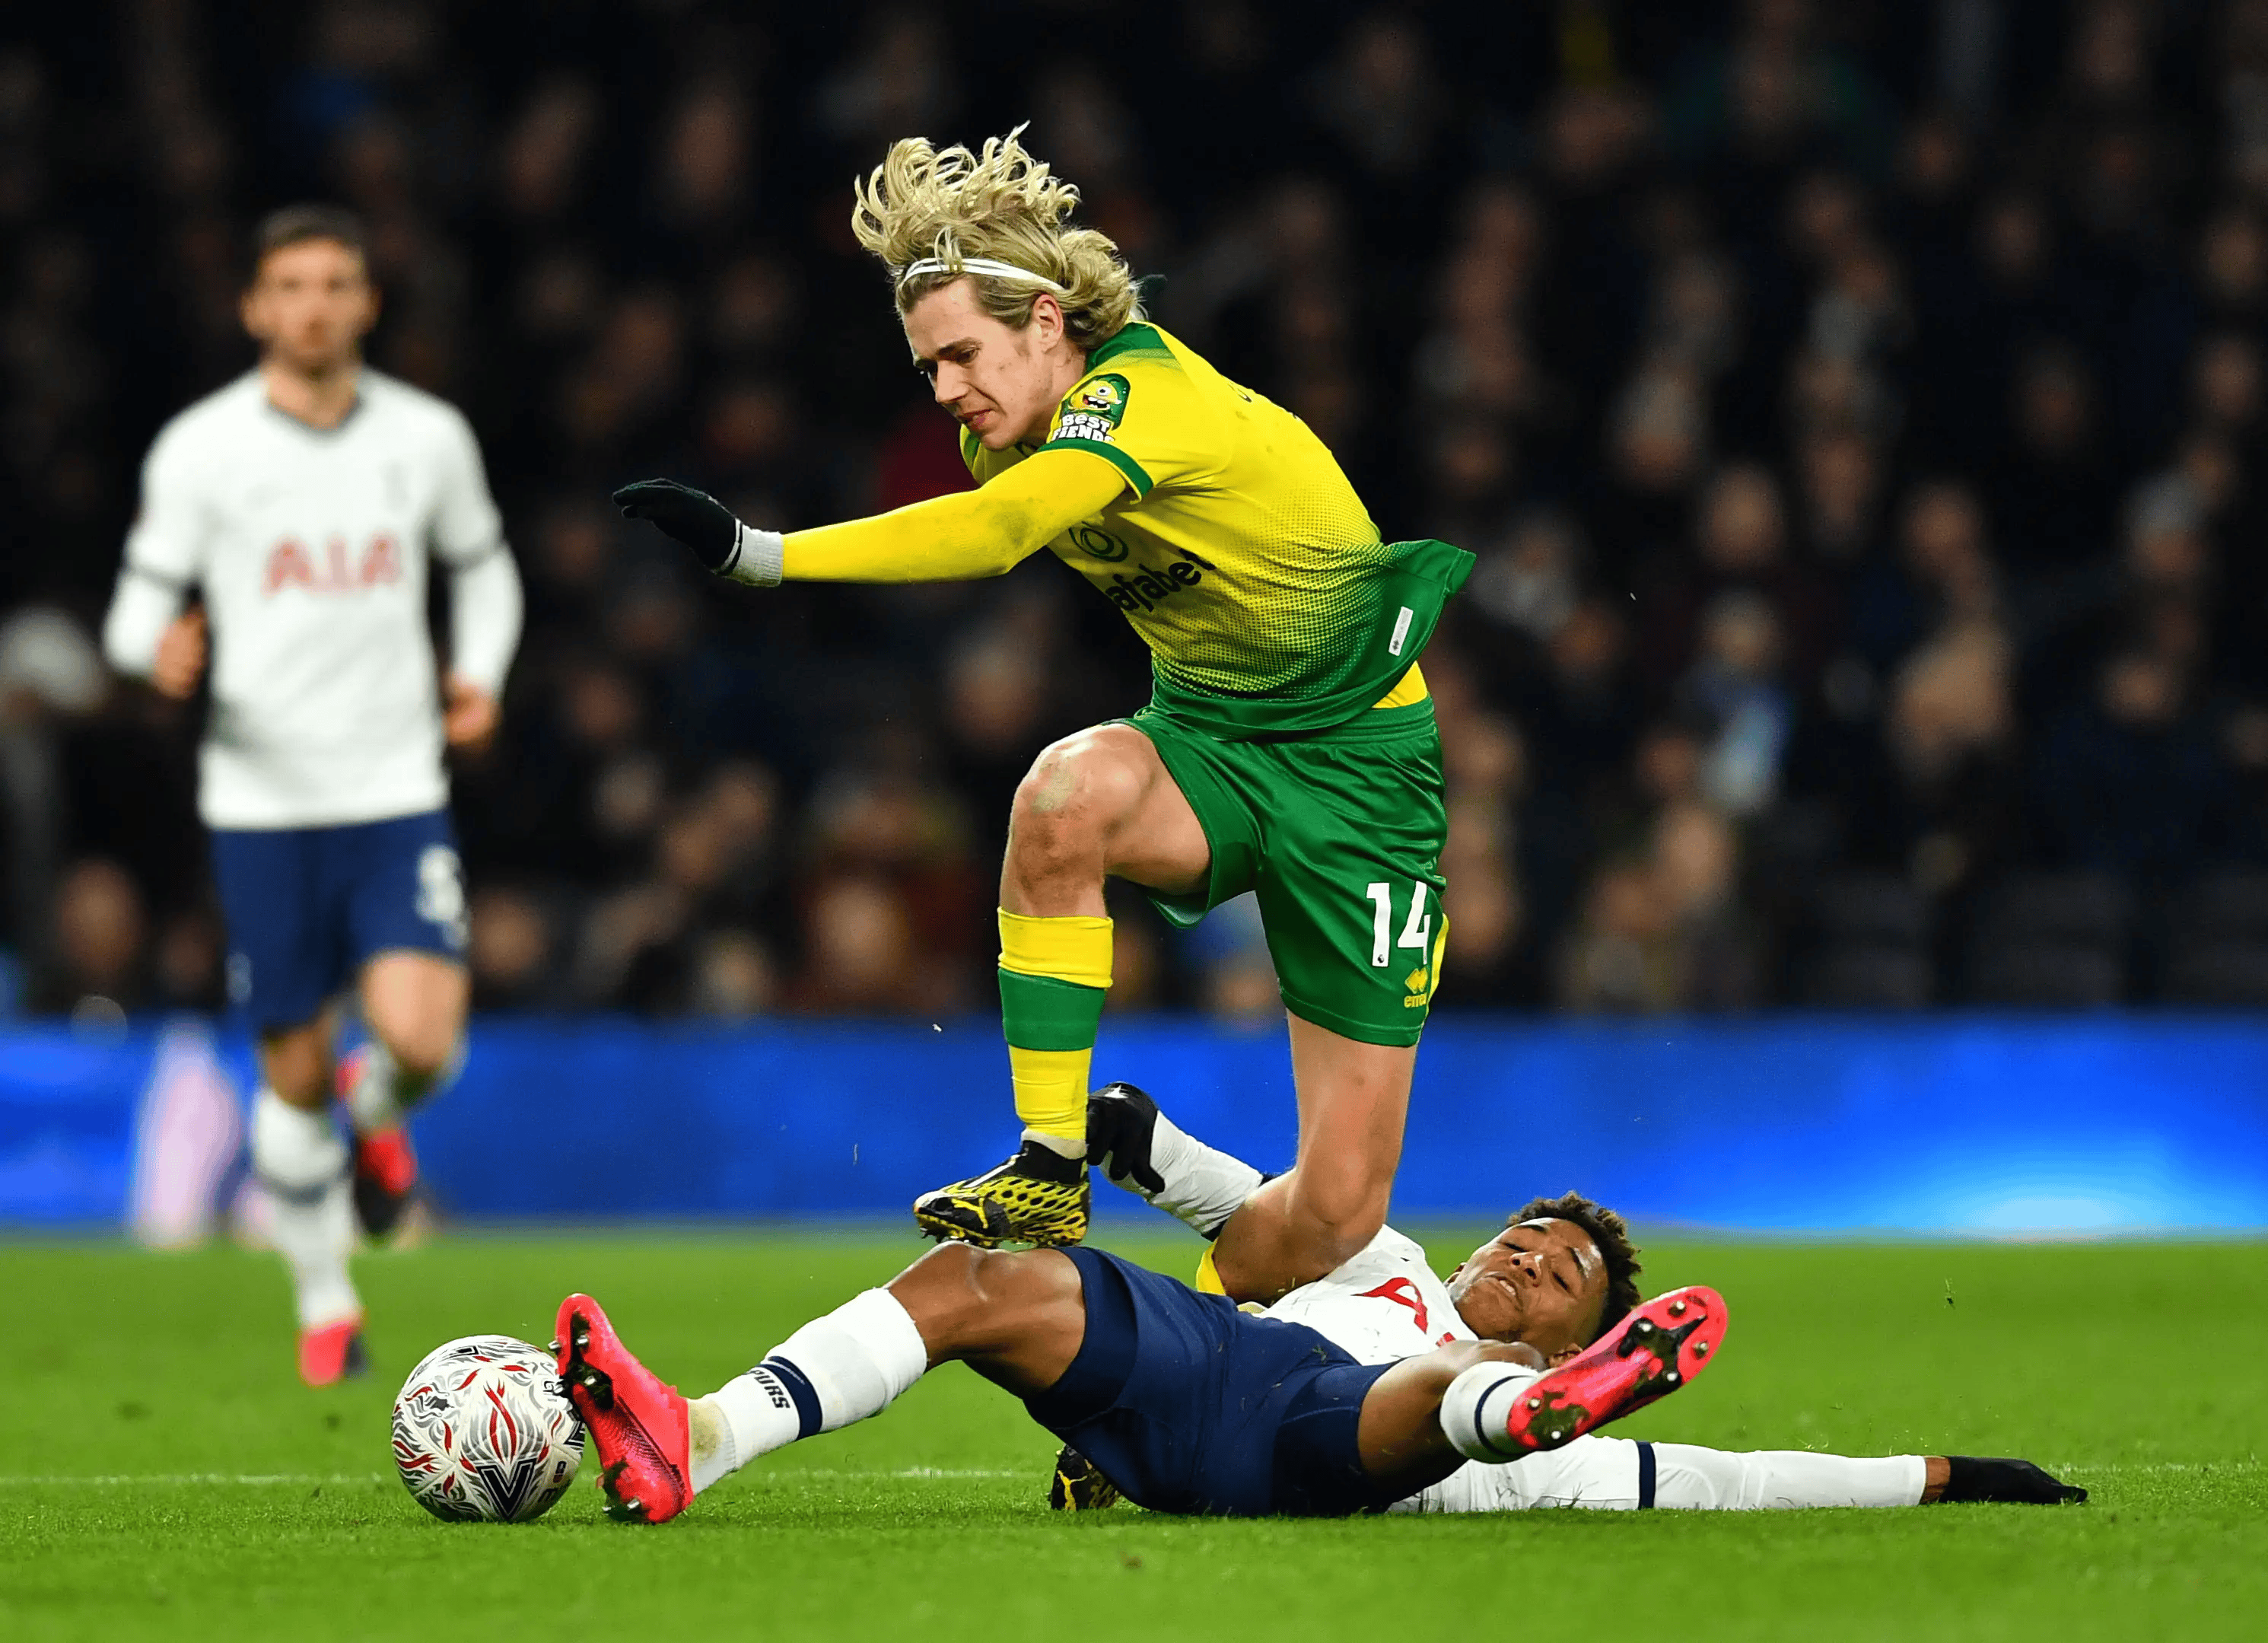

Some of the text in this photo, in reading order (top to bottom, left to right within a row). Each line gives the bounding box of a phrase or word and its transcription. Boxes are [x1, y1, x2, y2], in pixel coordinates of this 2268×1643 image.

[260, 530, 405, 600] AIA
[417, 843, 463, 925] 8
[1366, 880, 1431, 967] 14
[749, 1370, 790, 1409] PURS
